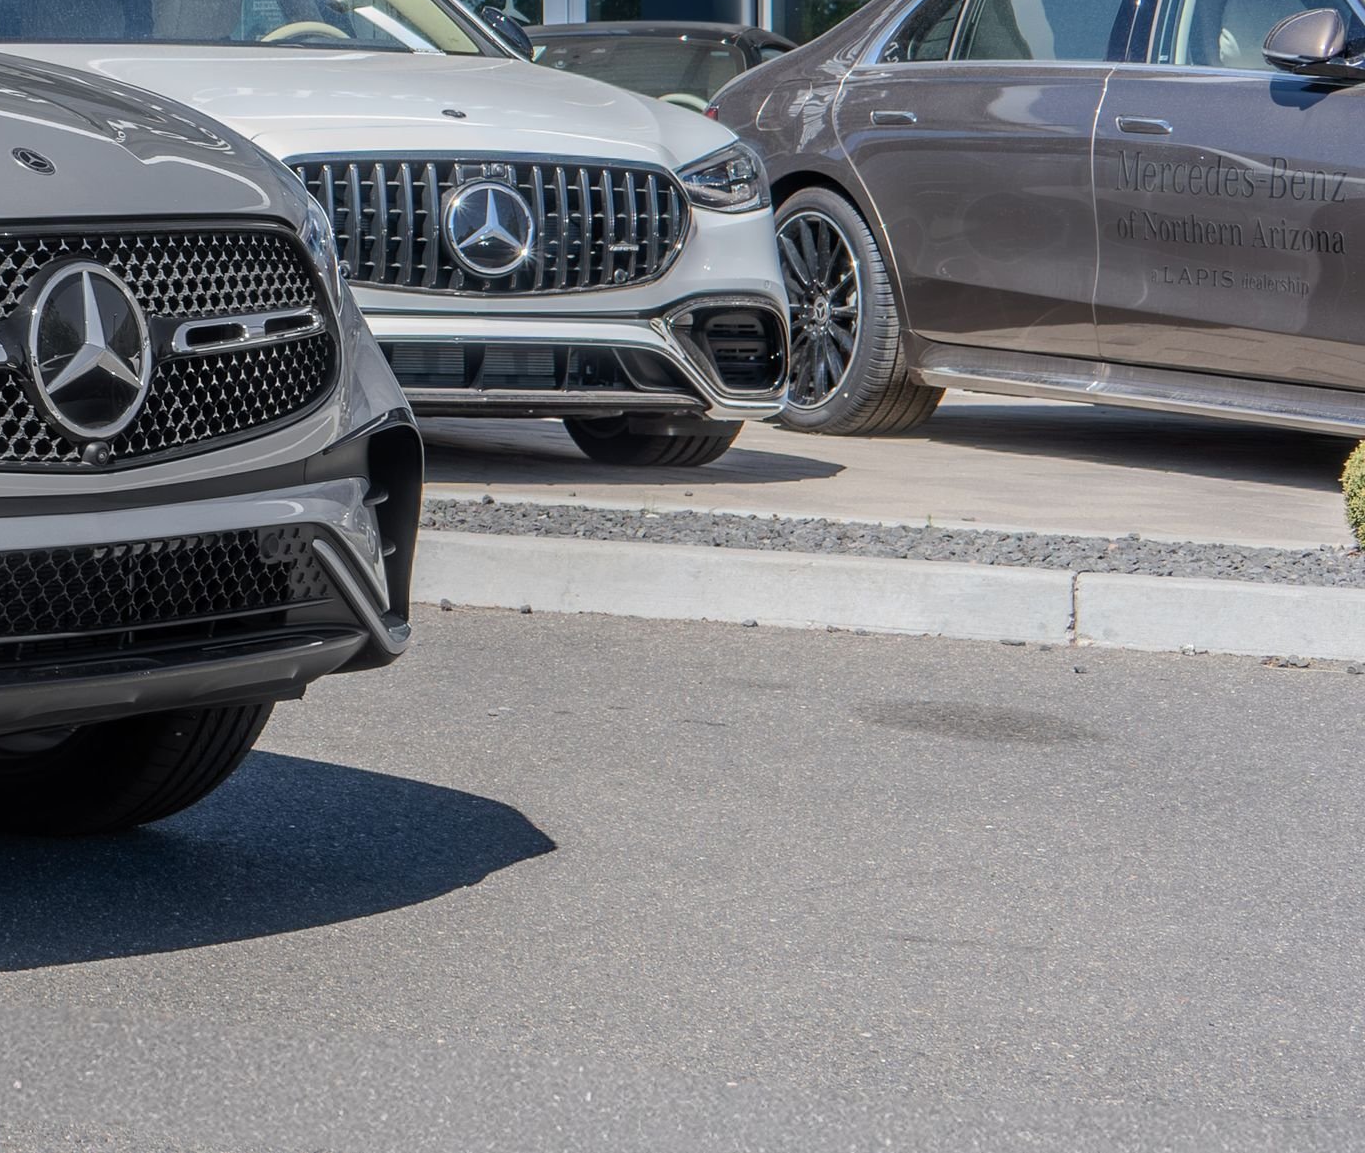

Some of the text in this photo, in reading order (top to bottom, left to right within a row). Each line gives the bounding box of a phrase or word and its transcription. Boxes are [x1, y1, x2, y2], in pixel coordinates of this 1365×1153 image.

[1116, 149, 1348, 203] Mercedes-Benz
[1117, 209, 1346, 255] of Northern Arizona
[1164, 266, 1235, 288] LAPIS
[1241, 275, 1310, 297] dealership
